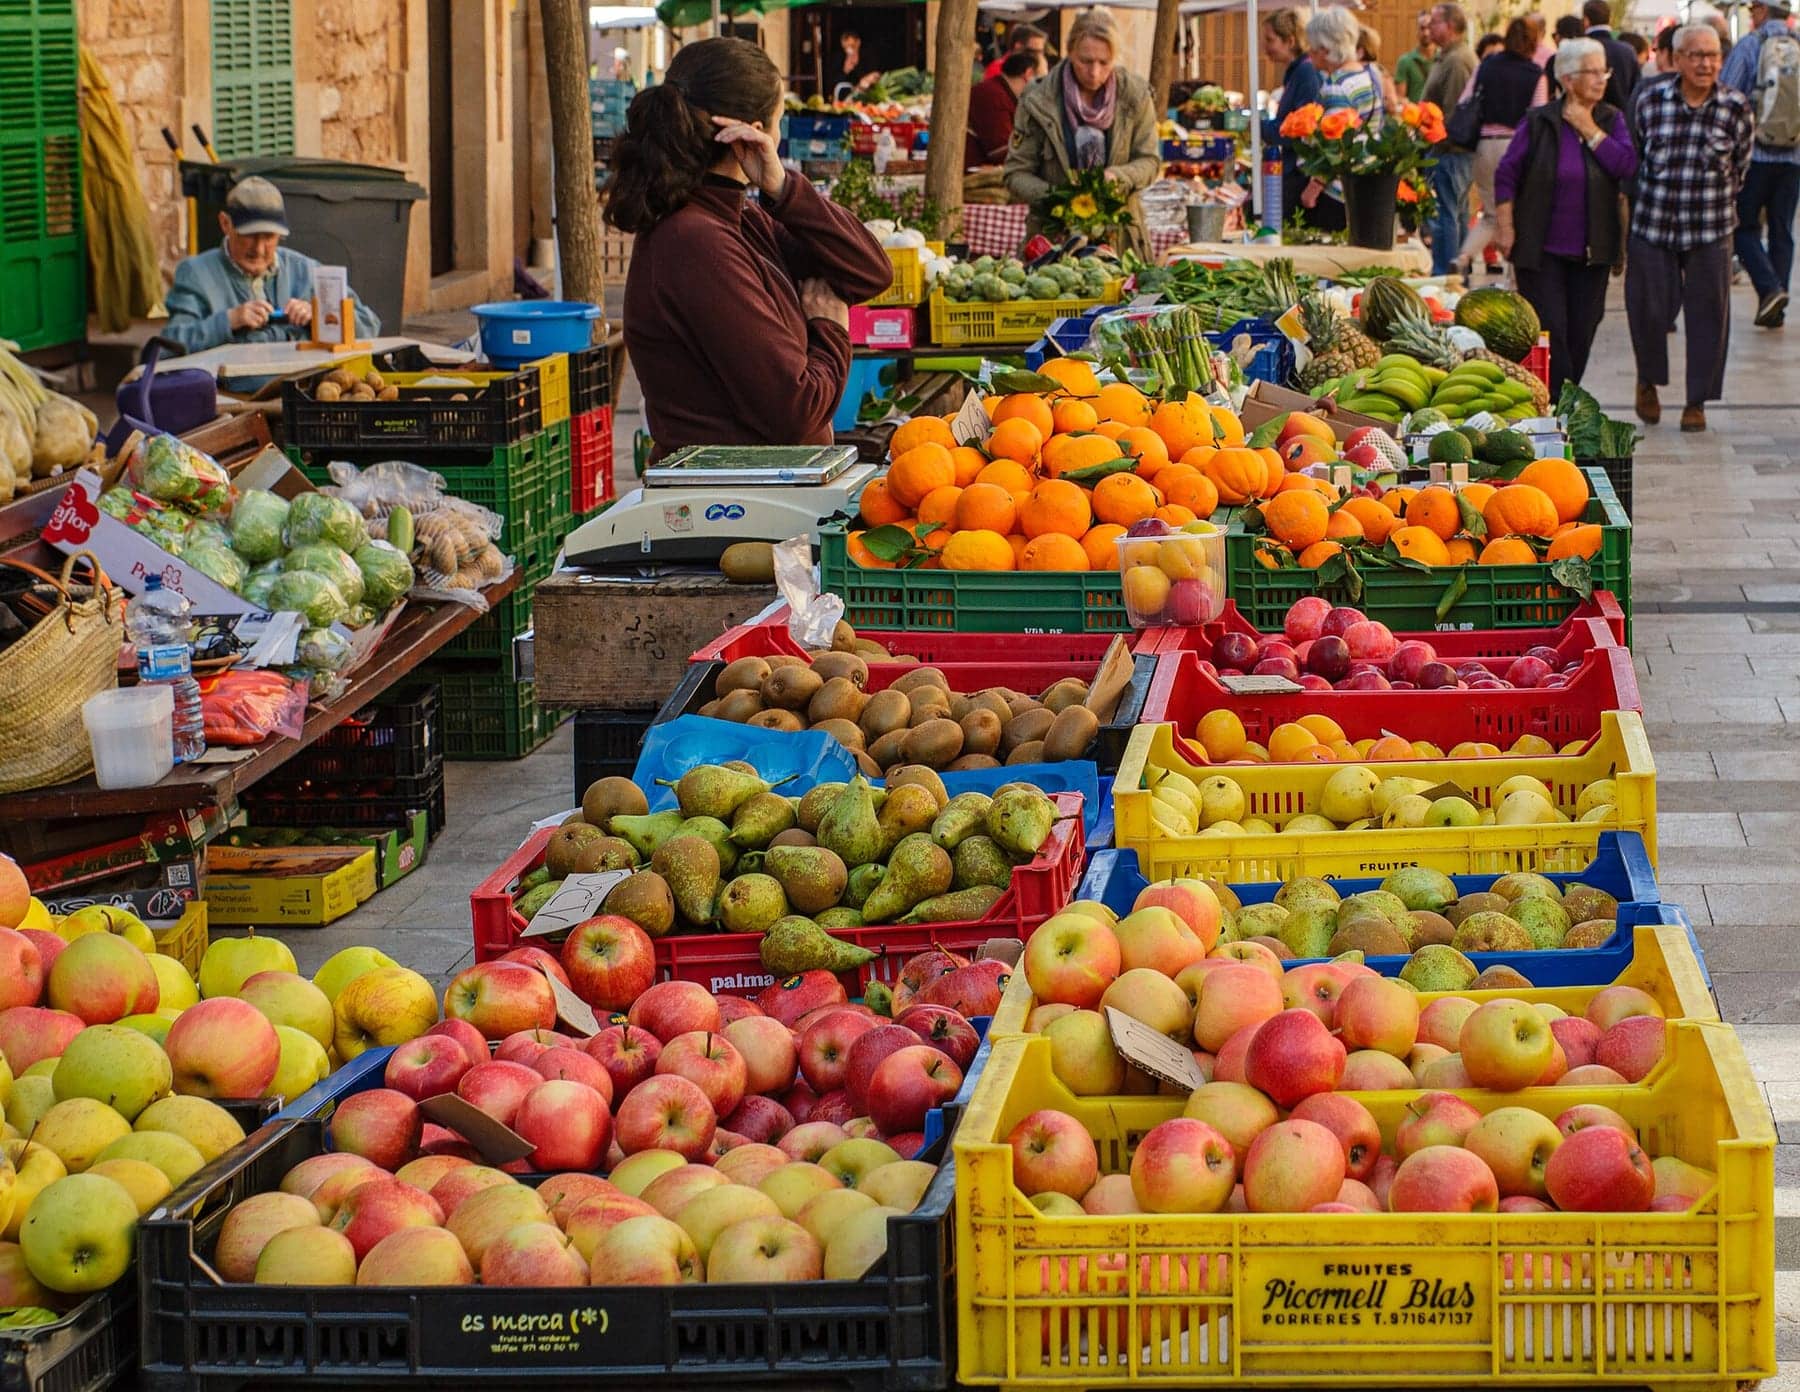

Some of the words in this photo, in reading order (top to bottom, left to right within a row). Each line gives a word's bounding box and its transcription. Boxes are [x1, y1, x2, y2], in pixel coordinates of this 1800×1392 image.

[1359, 861, 1419, 871] FRUITES
[710, 973, 775, 993] palma
[1323, 1263, 1413, 1276] FRUITES
[1262, 1278, 1388, 1310] Picornell
[1400, 1278, 1475, 1310] Blas
[461, 1313, 485, 1333] es
[491, 1312, 564, 1332] merca
[1262, 1312, 1362, 1325] PORRERES
